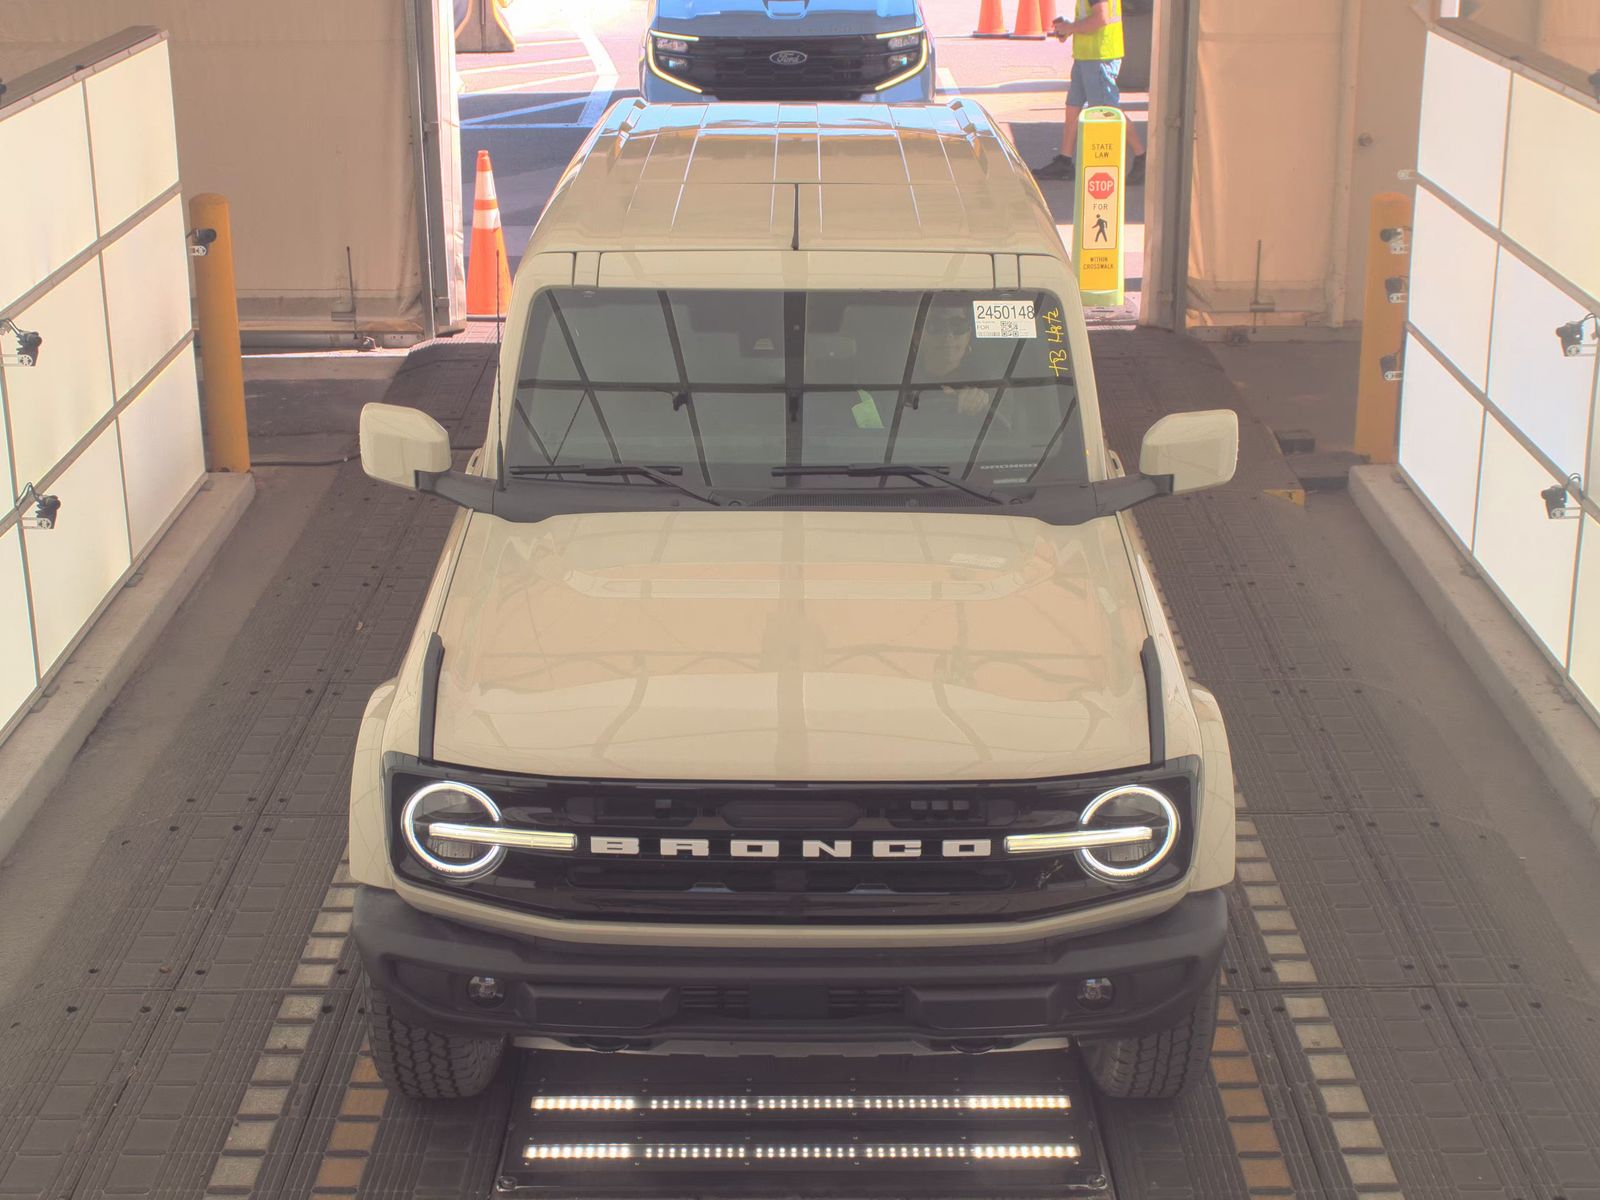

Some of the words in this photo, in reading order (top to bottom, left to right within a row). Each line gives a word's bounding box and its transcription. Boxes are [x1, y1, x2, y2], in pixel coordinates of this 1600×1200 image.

[1088, 180, 1114, 192] STOP
[976, 305, 1035, 320] 2450148
[590, 836, 992, 858] BRONCO
